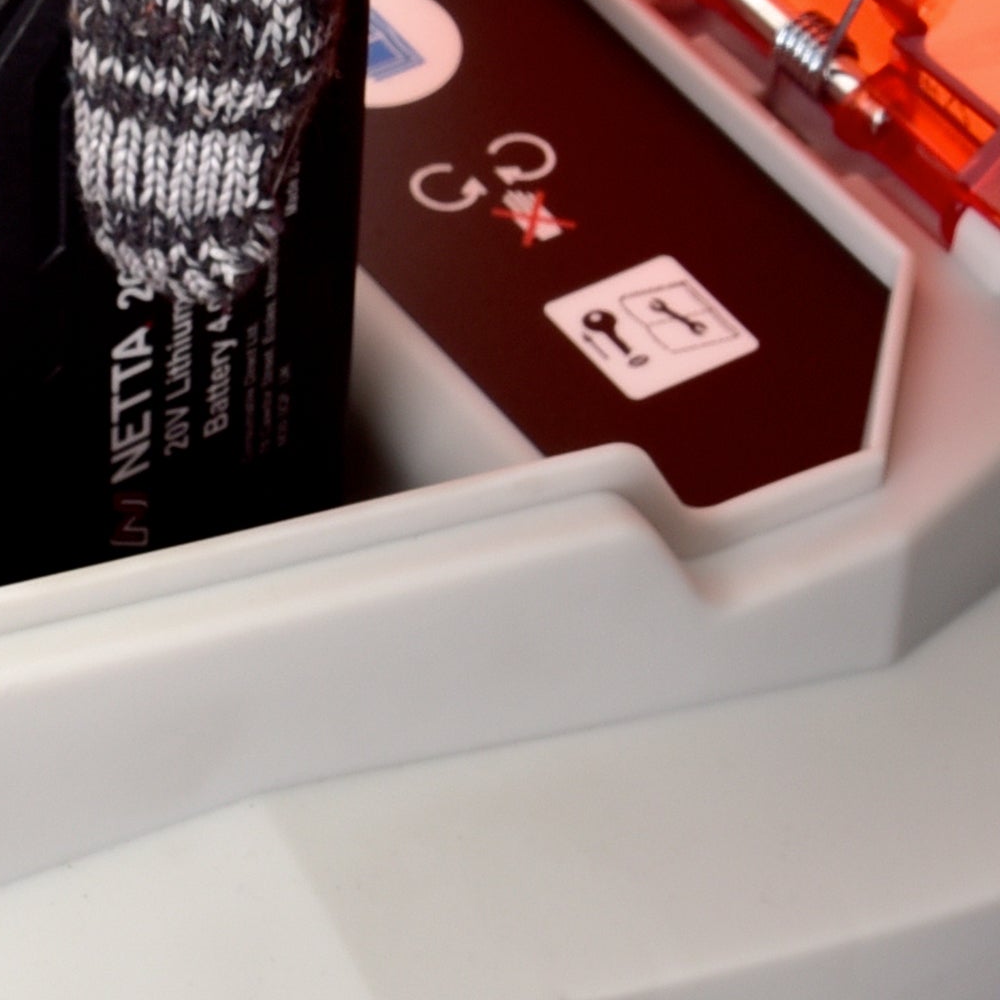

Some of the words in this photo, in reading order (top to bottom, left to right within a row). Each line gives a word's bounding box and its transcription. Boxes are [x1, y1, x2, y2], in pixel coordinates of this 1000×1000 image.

[111, 324, 154, 484] NETTA
[164, 406, 190, 456] 20V
[204, 336, 238, 438] Battery
